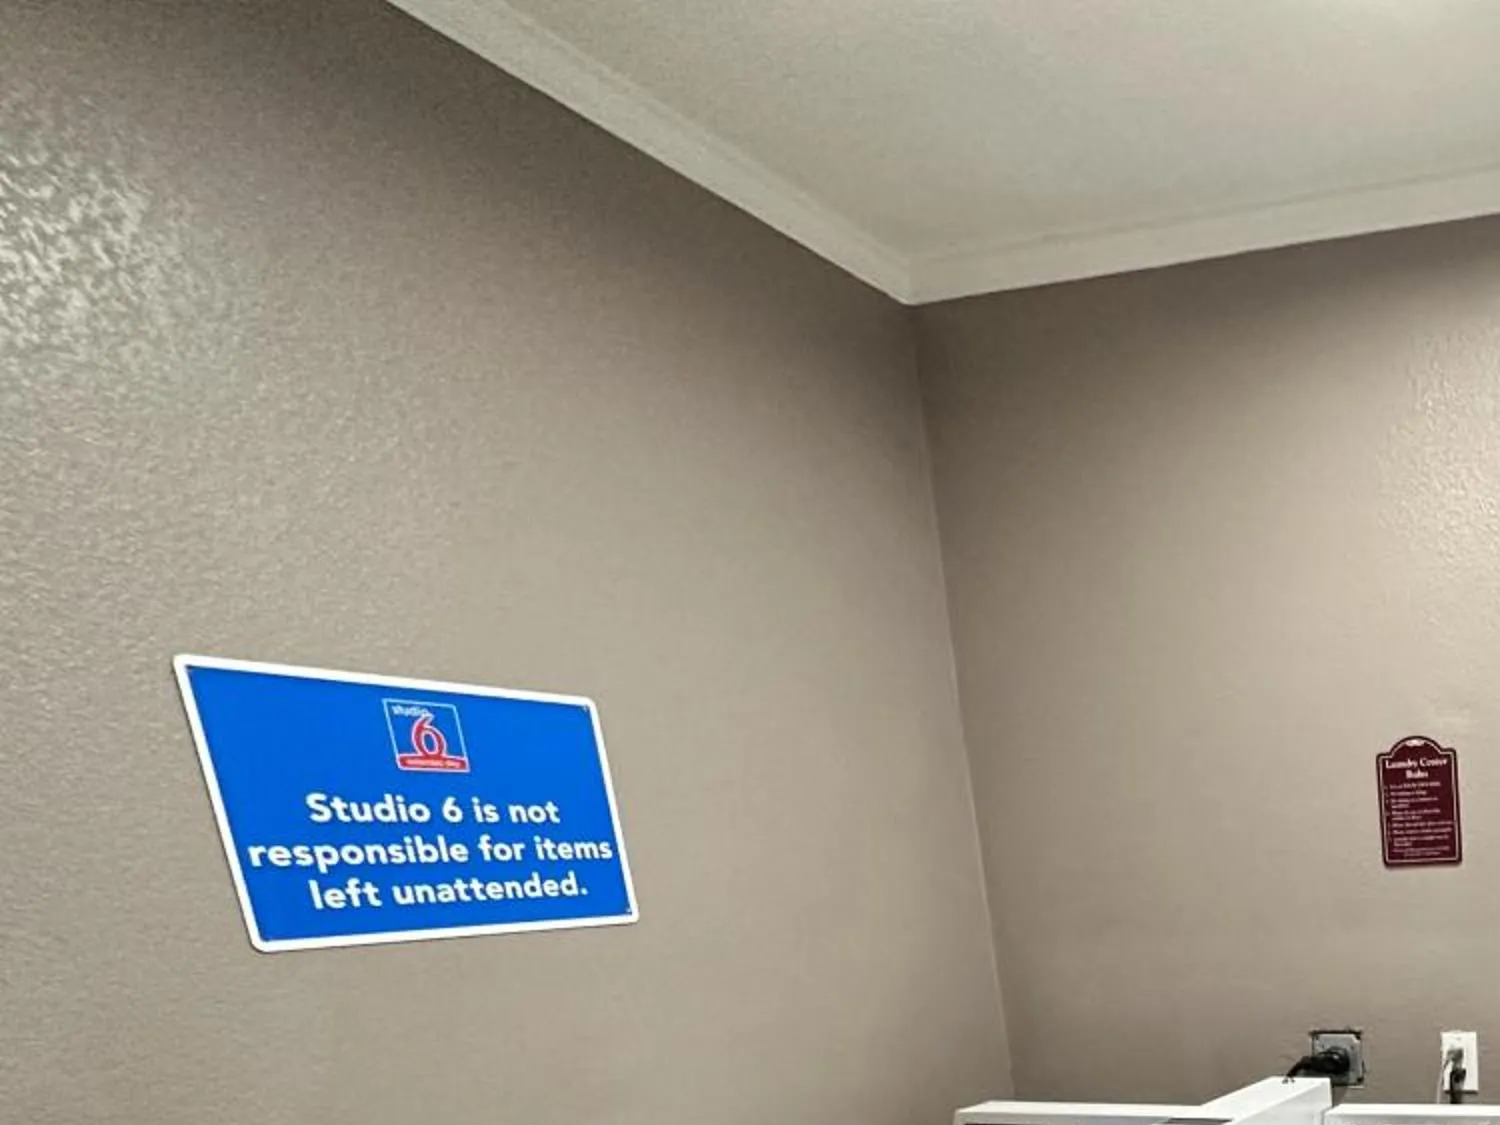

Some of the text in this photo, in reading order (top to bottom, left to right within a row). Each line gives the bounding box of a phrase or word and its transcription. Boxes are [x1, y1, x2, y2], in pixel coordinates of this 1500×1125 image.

[411, 714, 447, 758] 6
[306, 793, 560, 823] Studio 6 is not
[248, 834, 613, 873] responsible for items
[309, 871, 588, 909] left unattended.
